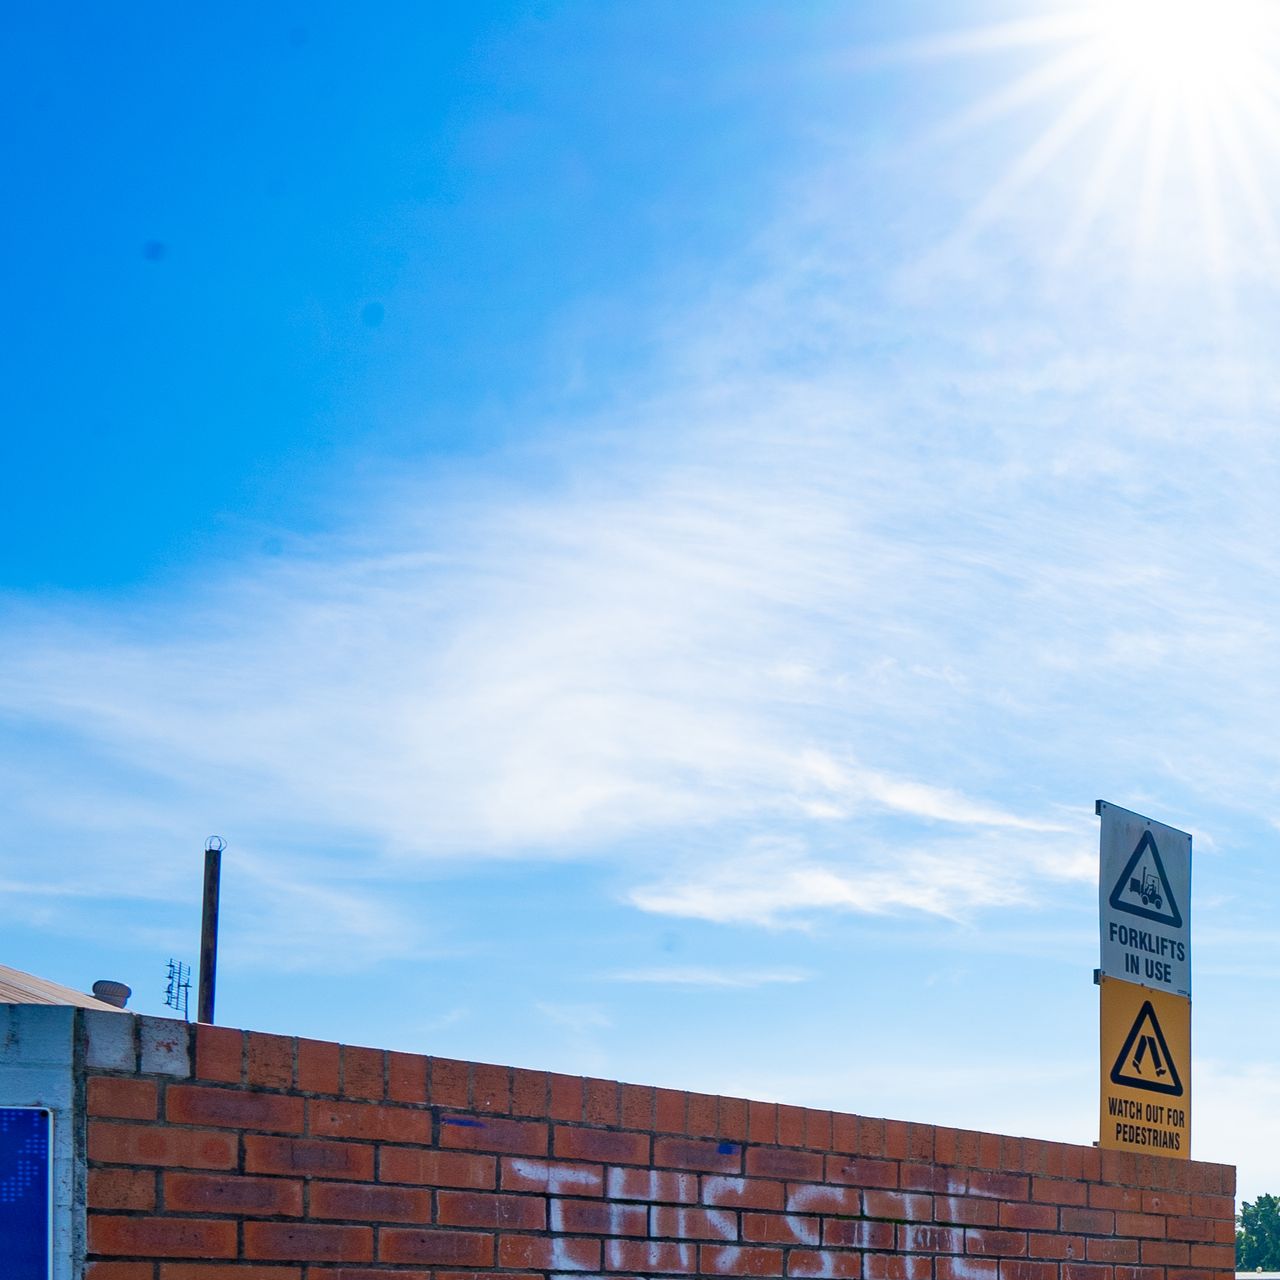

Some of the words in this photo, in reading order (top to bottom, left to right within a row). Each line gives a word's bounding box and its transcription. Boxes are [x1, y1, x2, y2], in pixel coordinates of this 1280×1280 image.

[1109, 922, 1185, 961] FORKLIFTS
[1125, 952, 1139, 975] IN
[1145, 957, 1171, 983] USE
[1108, 1096, 1143, 1121] WATCH
[1145, 1103, 1164, 1124] OUT
[1167, 1106, 1185, 1128] FOR
[1115, 1123, 1180, 1151] PEDESTRIANS
[511, 1159, 746, 1272] THIS
